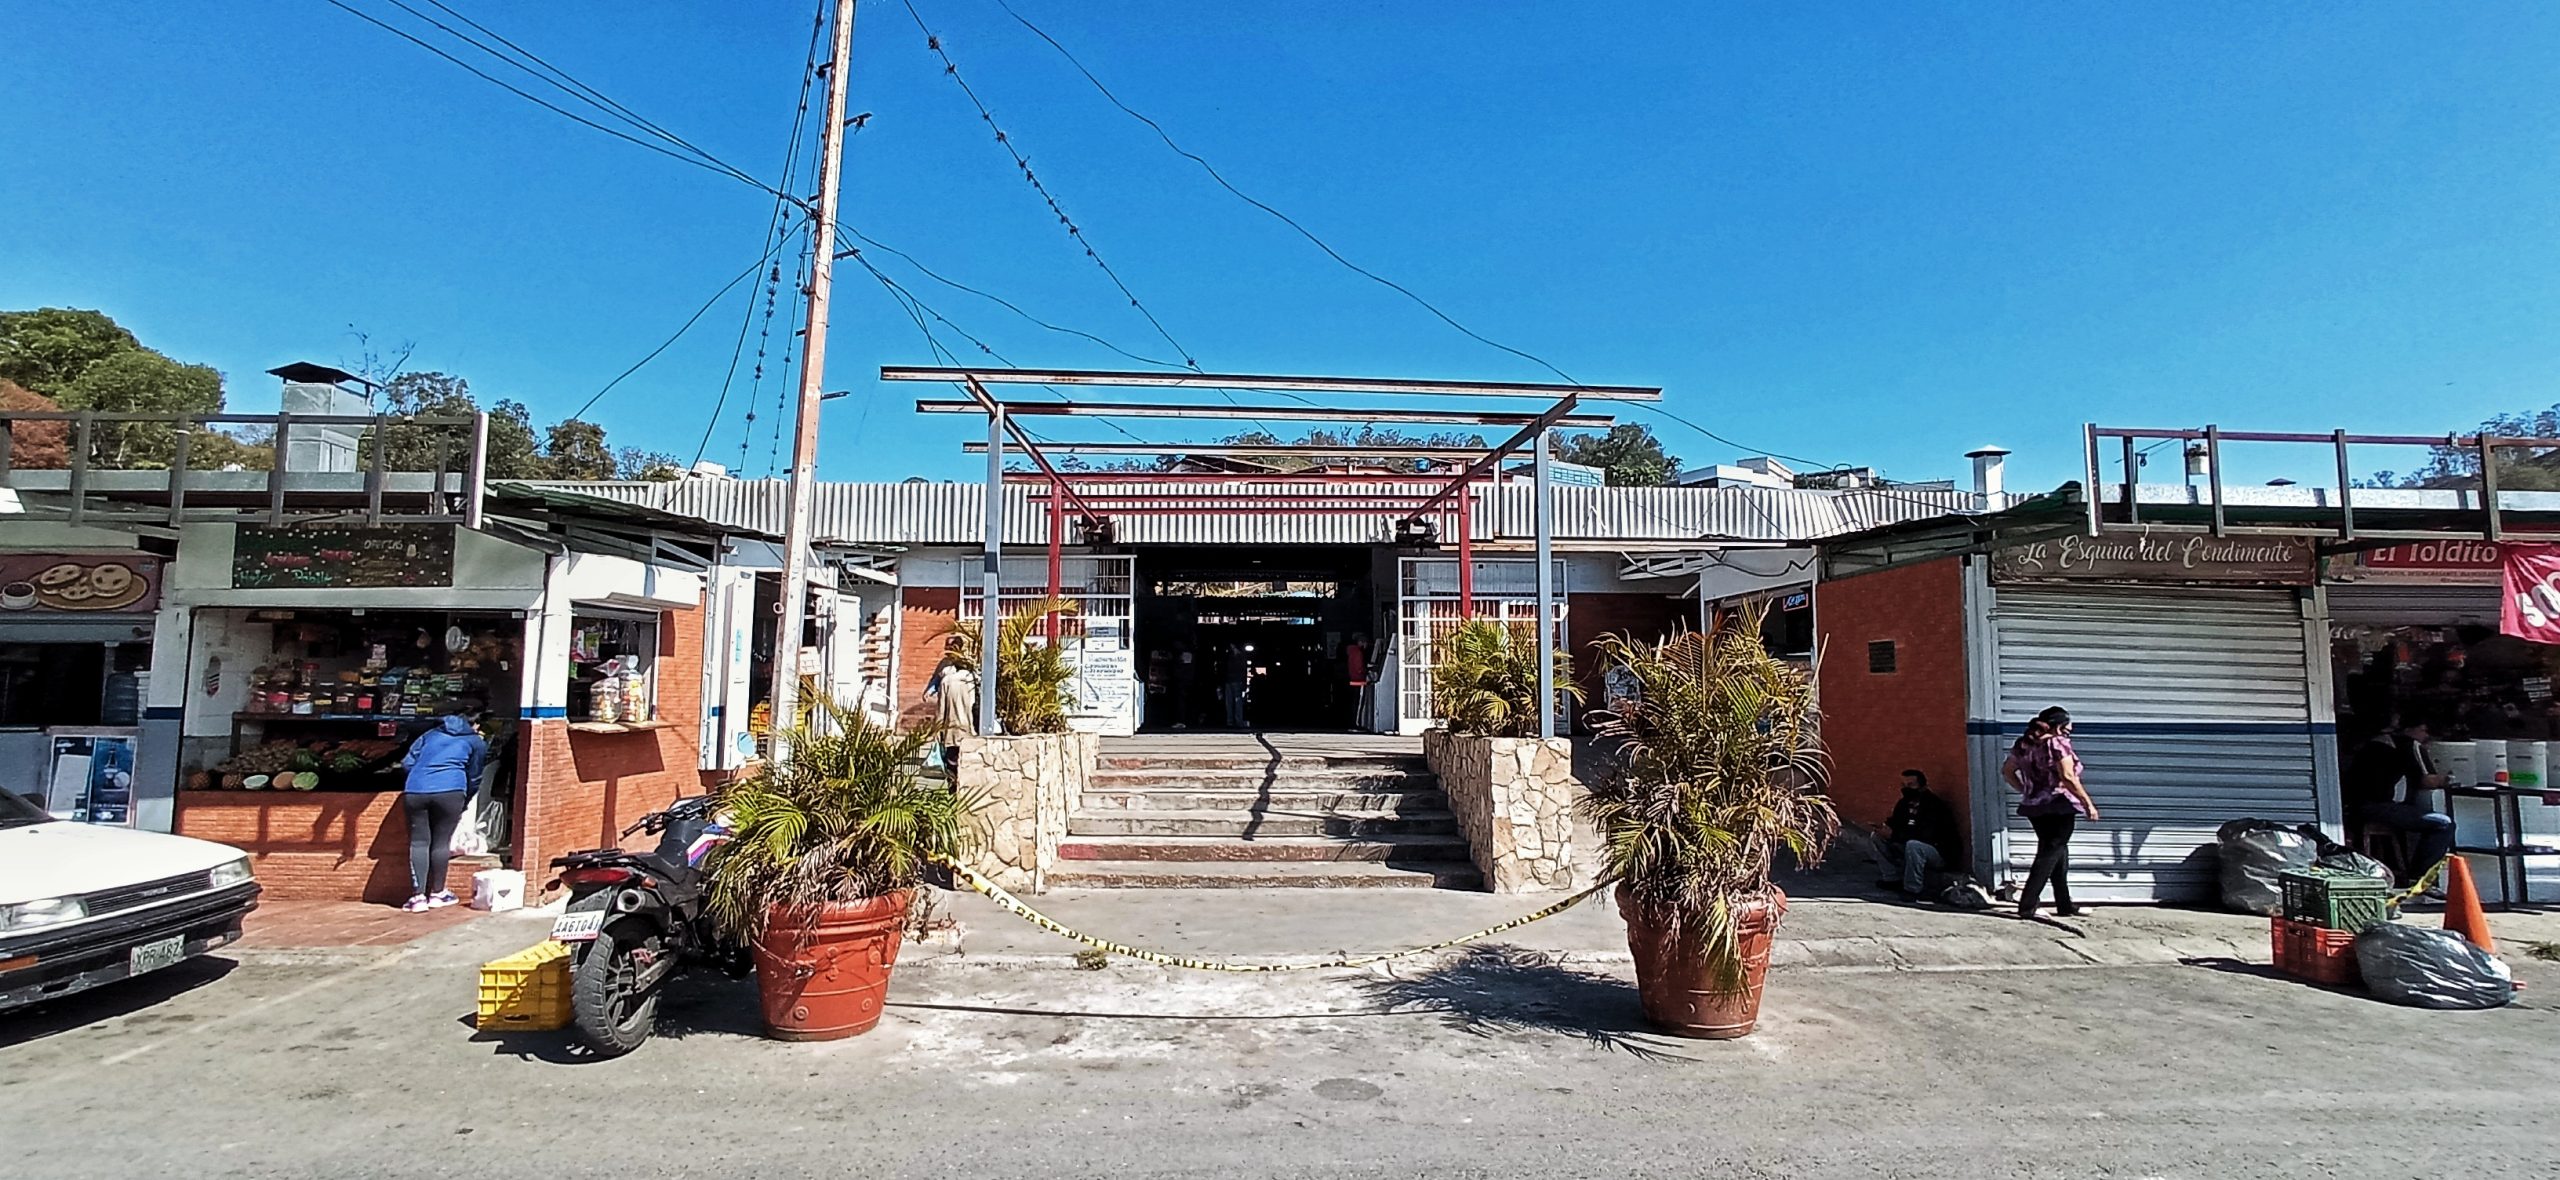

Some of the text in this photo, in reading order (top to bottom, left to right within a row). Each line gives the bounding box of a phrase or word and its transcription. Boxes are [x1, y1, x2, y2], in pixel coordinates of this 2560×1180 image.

[2018, 534, 2294, 570] La Esquina del Condimento
